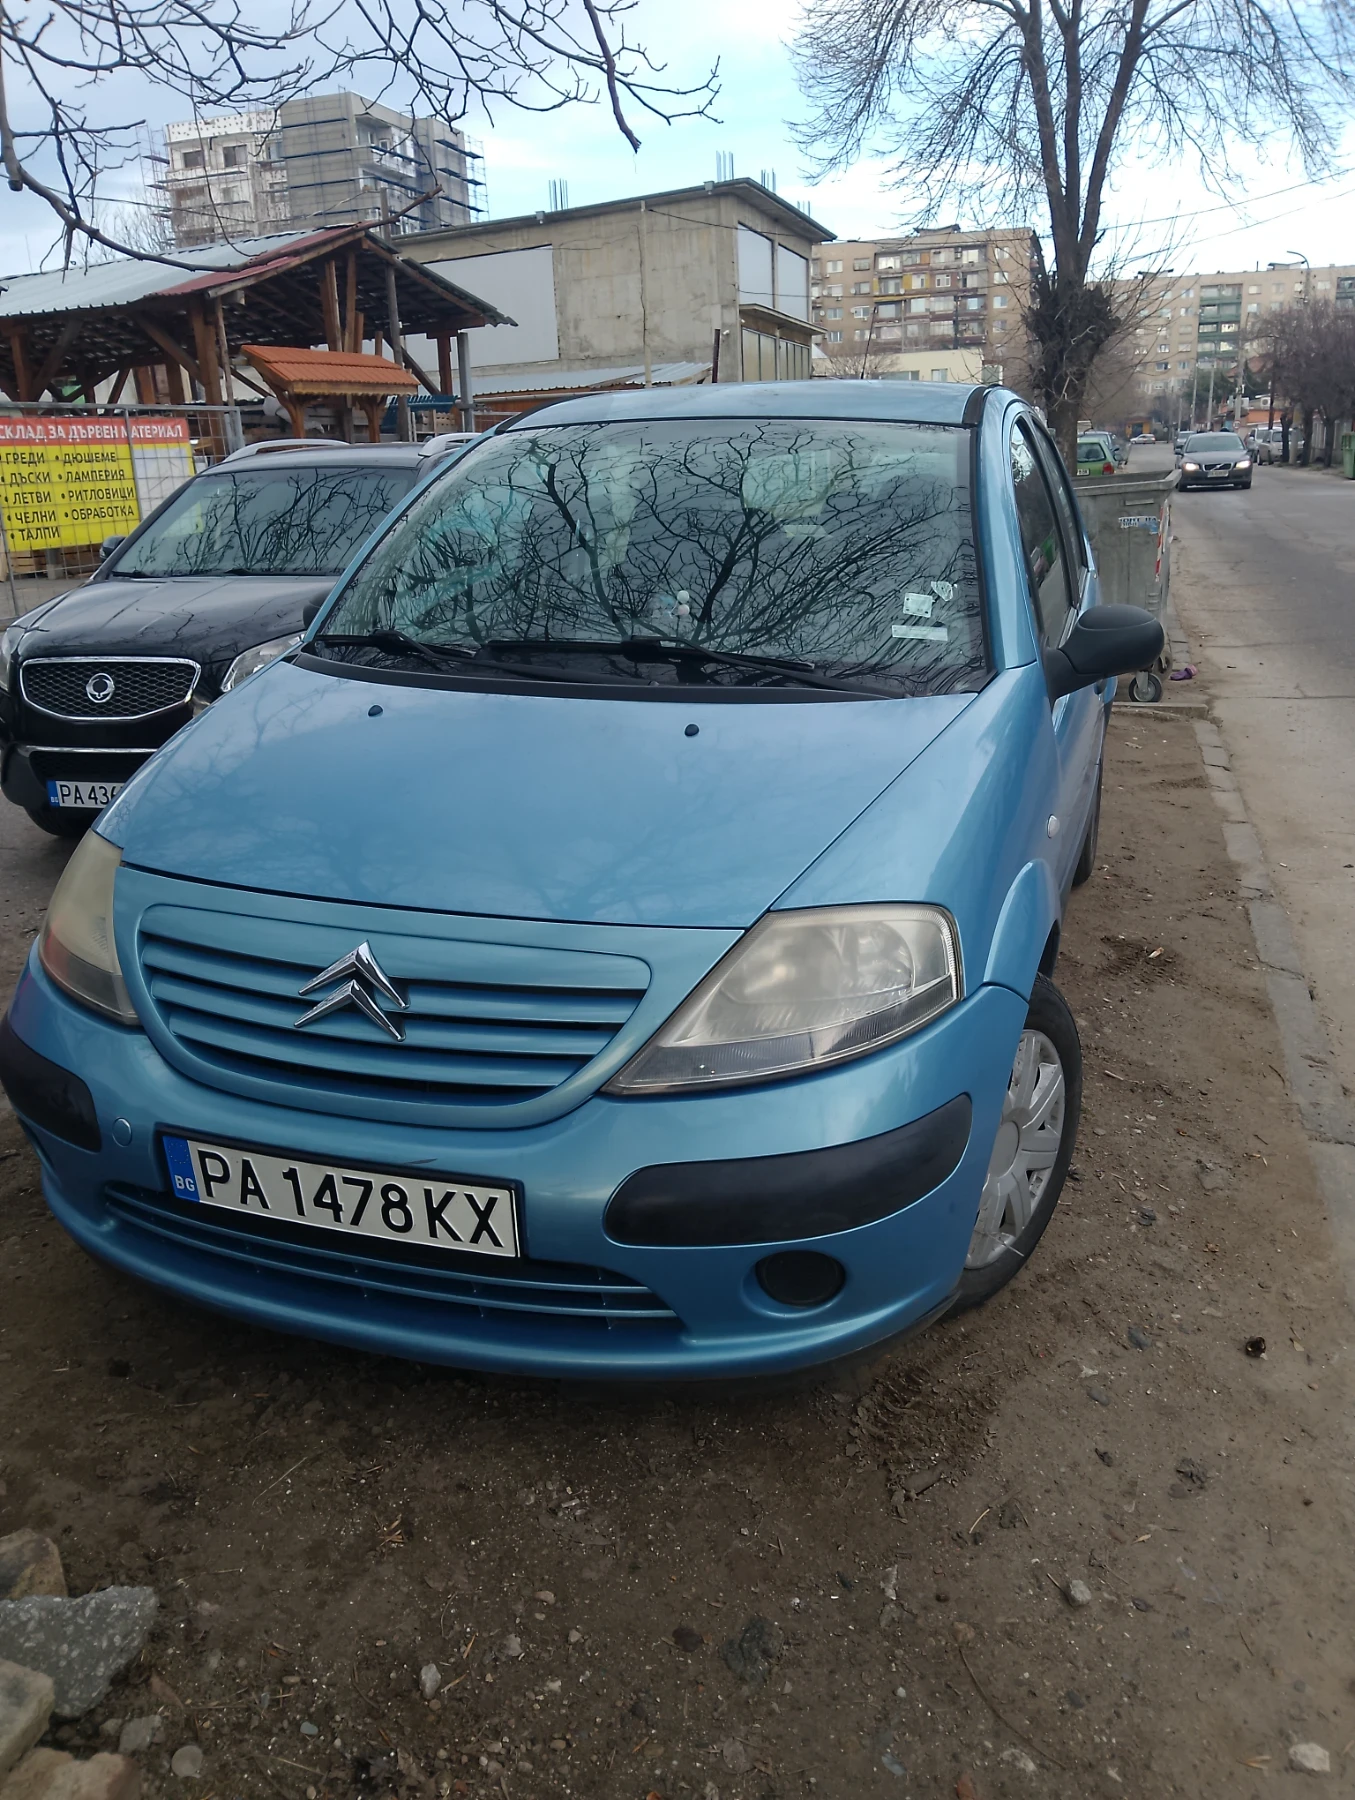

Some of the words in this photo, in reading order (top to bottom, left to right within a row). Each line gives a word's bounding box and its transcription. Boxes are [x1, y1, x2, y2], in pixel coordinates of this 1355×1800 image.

[48, 425, 65, 439] ЗА
[68, 425, 118, 442] ДЪРВЕН
[5, 452, 45, 467] ГРЕДИ
[63, 452, 117, 466] ДЮШЕМЕ
[10, 472, 51, 487] ДЪСКИ
[66, 469, 125, 483] ЛАМПЕРИЯ
[13, 491, 52, 505] ЛЕТВИ
[68, 487, 134, 501] РИТЛОВИЦИ
[15, 510, 56, 524] ЧЕЛНИ
[71, 505, 134, 520] ОБРАБОТКА
[18, 526, 60, 541] ТАЛПИ
[59, 784, 85, 804] PA
[174, 1174, 195, 1192] BG
[197, 1148, 271, 1209] PA
[282, 1166, 414, 1234] 1478
[423, 1187, 505, 1248] KX
